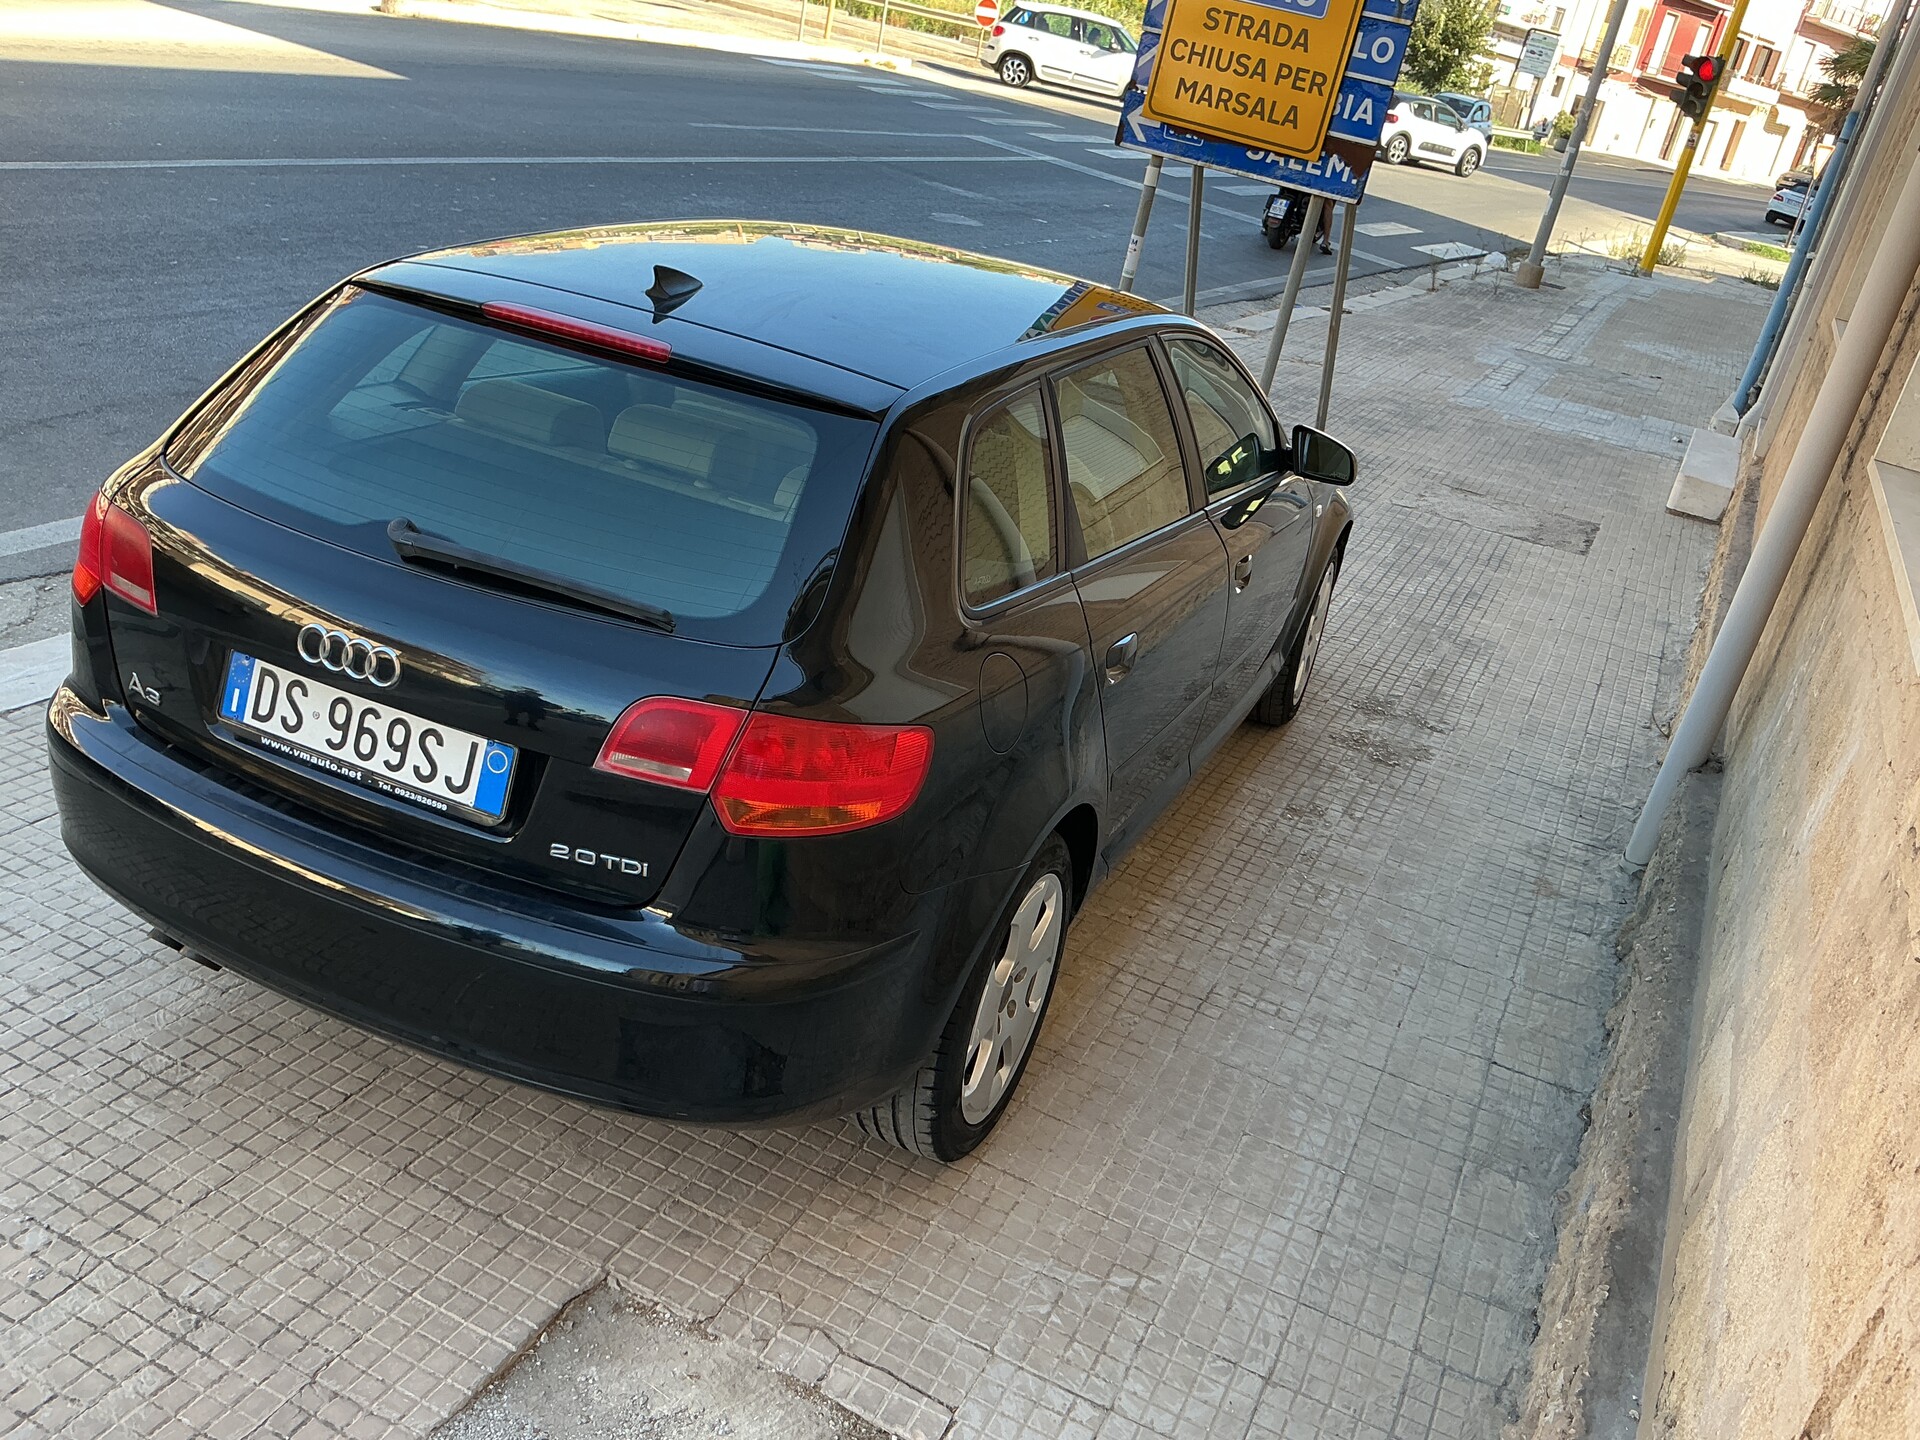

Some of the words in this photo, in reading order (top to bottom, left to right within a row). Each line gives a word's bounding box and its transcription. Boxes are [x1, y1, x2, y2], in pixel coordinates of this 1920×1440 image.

[1202, 7, 1310, 53] STRADA
[1170, 38, 1267, 83] CHIUSA
[1274, 62, 1328, 97] PER
[1174, 77, 1299, 130] MARSALA
[128, 671, 161, 706] A3
[251, 666, 309, 734] DS
[325, 696, 480, 794] 969SJ
[260, 736, 363, 781] www.vmauto.net
[378, 781, 393, 792] Tel.
[394, 787, 448, 811] 0923/526599
